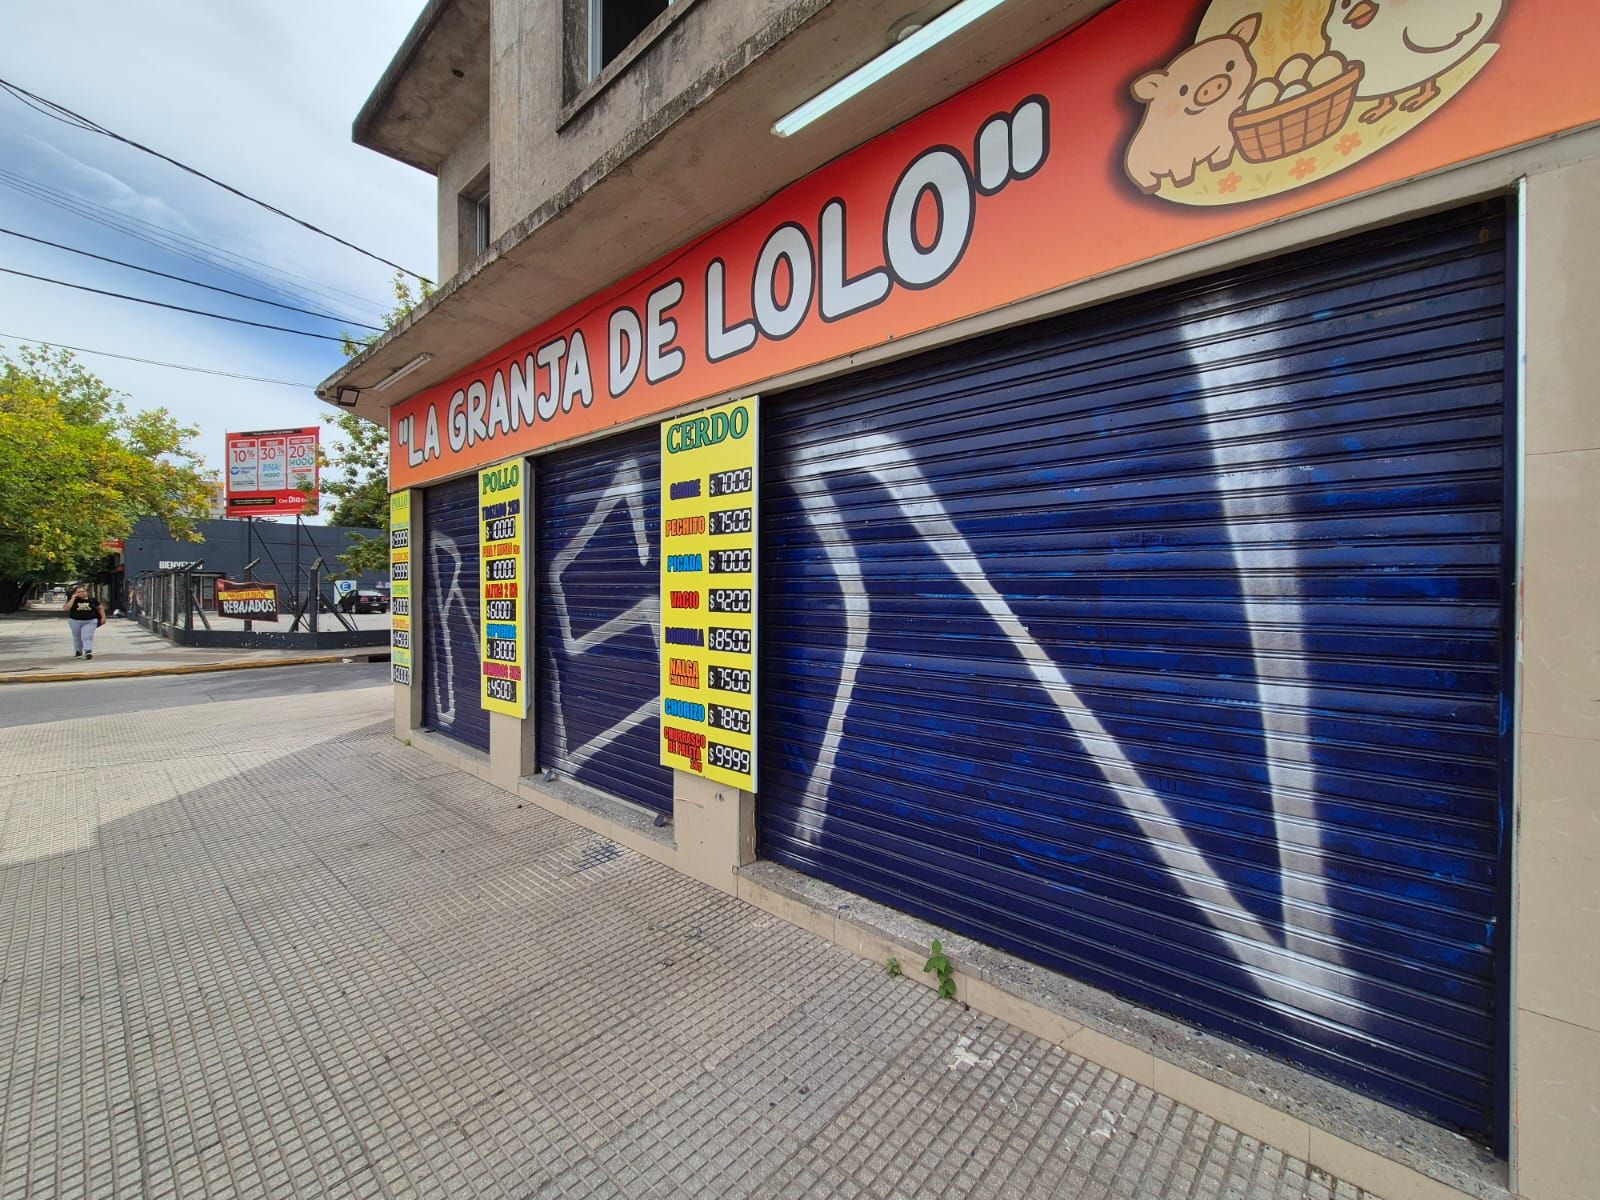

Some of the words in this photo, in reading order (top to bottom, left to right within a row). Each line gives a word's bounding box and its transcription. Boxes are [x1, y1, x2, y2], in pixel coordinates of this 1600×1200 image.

[399, 403, 441, 468] "LA
[448, 328, 593, 453] GRANJA
[608, 277, 685, 399] DE
[705, 94, 1051, 364] LOLO"
[667, 405, 749, 454] CERDO
[482, 464, 519, 495] POLLO
[665, 516, 705, 537] PECHITO
[667, 554, 702, 573] PICADA
[223, 599, 276, 614] REBAJADOS!
[670, 590, 699, 609] VACIO
[669, 657, 699, 677] NALGA
[665, 697, 705, 723] CHORIZO
[664, 725, 707, 750] CHURRASCO
[676, 739, 702, 762] PALETA
